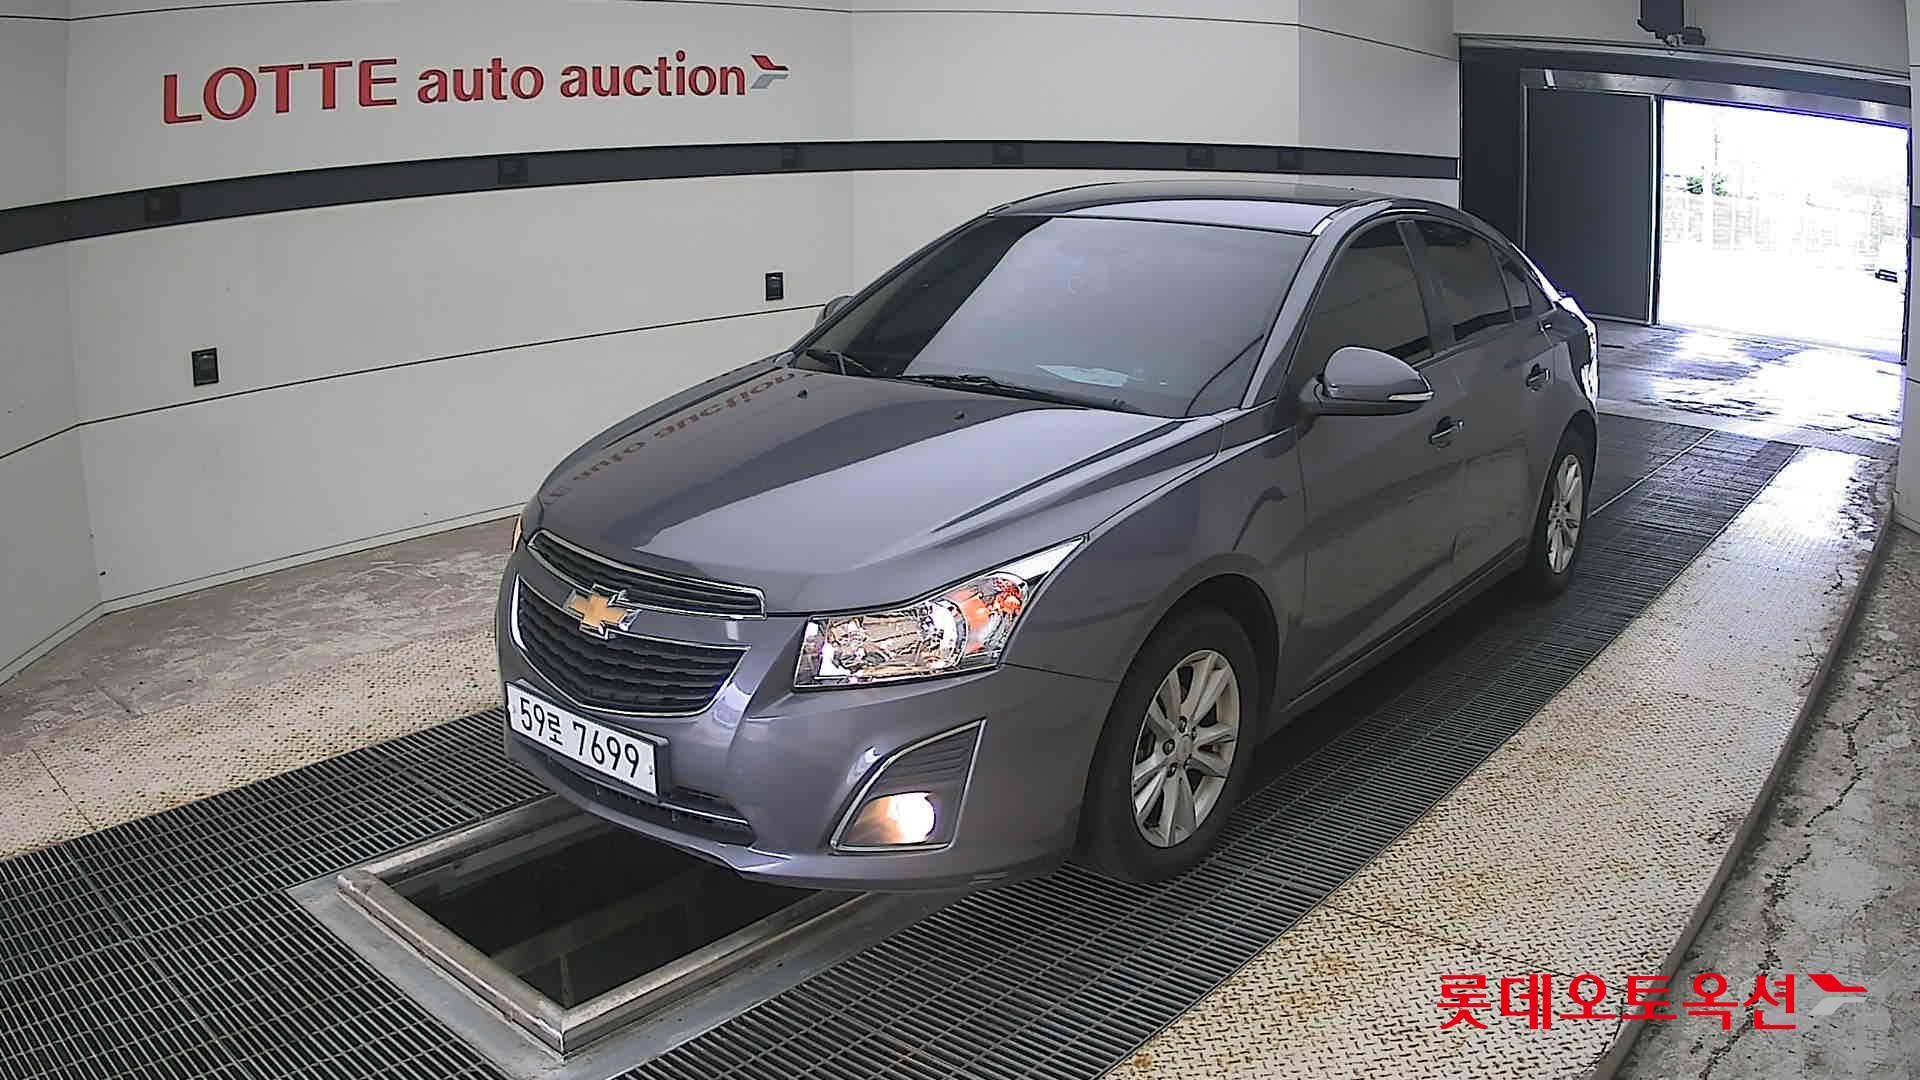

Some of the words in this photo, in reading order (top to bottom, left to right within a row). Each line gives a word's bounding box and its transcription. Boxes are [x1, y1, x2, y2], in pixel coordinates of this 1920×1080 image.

[163, 58, 397, 124] LOTTE
[417, 56, 545, 103] auto
[560, 51, 746, 97] auction
[520, 697, 563, 746] 59로
[573, 721, 640, 778] 7699
